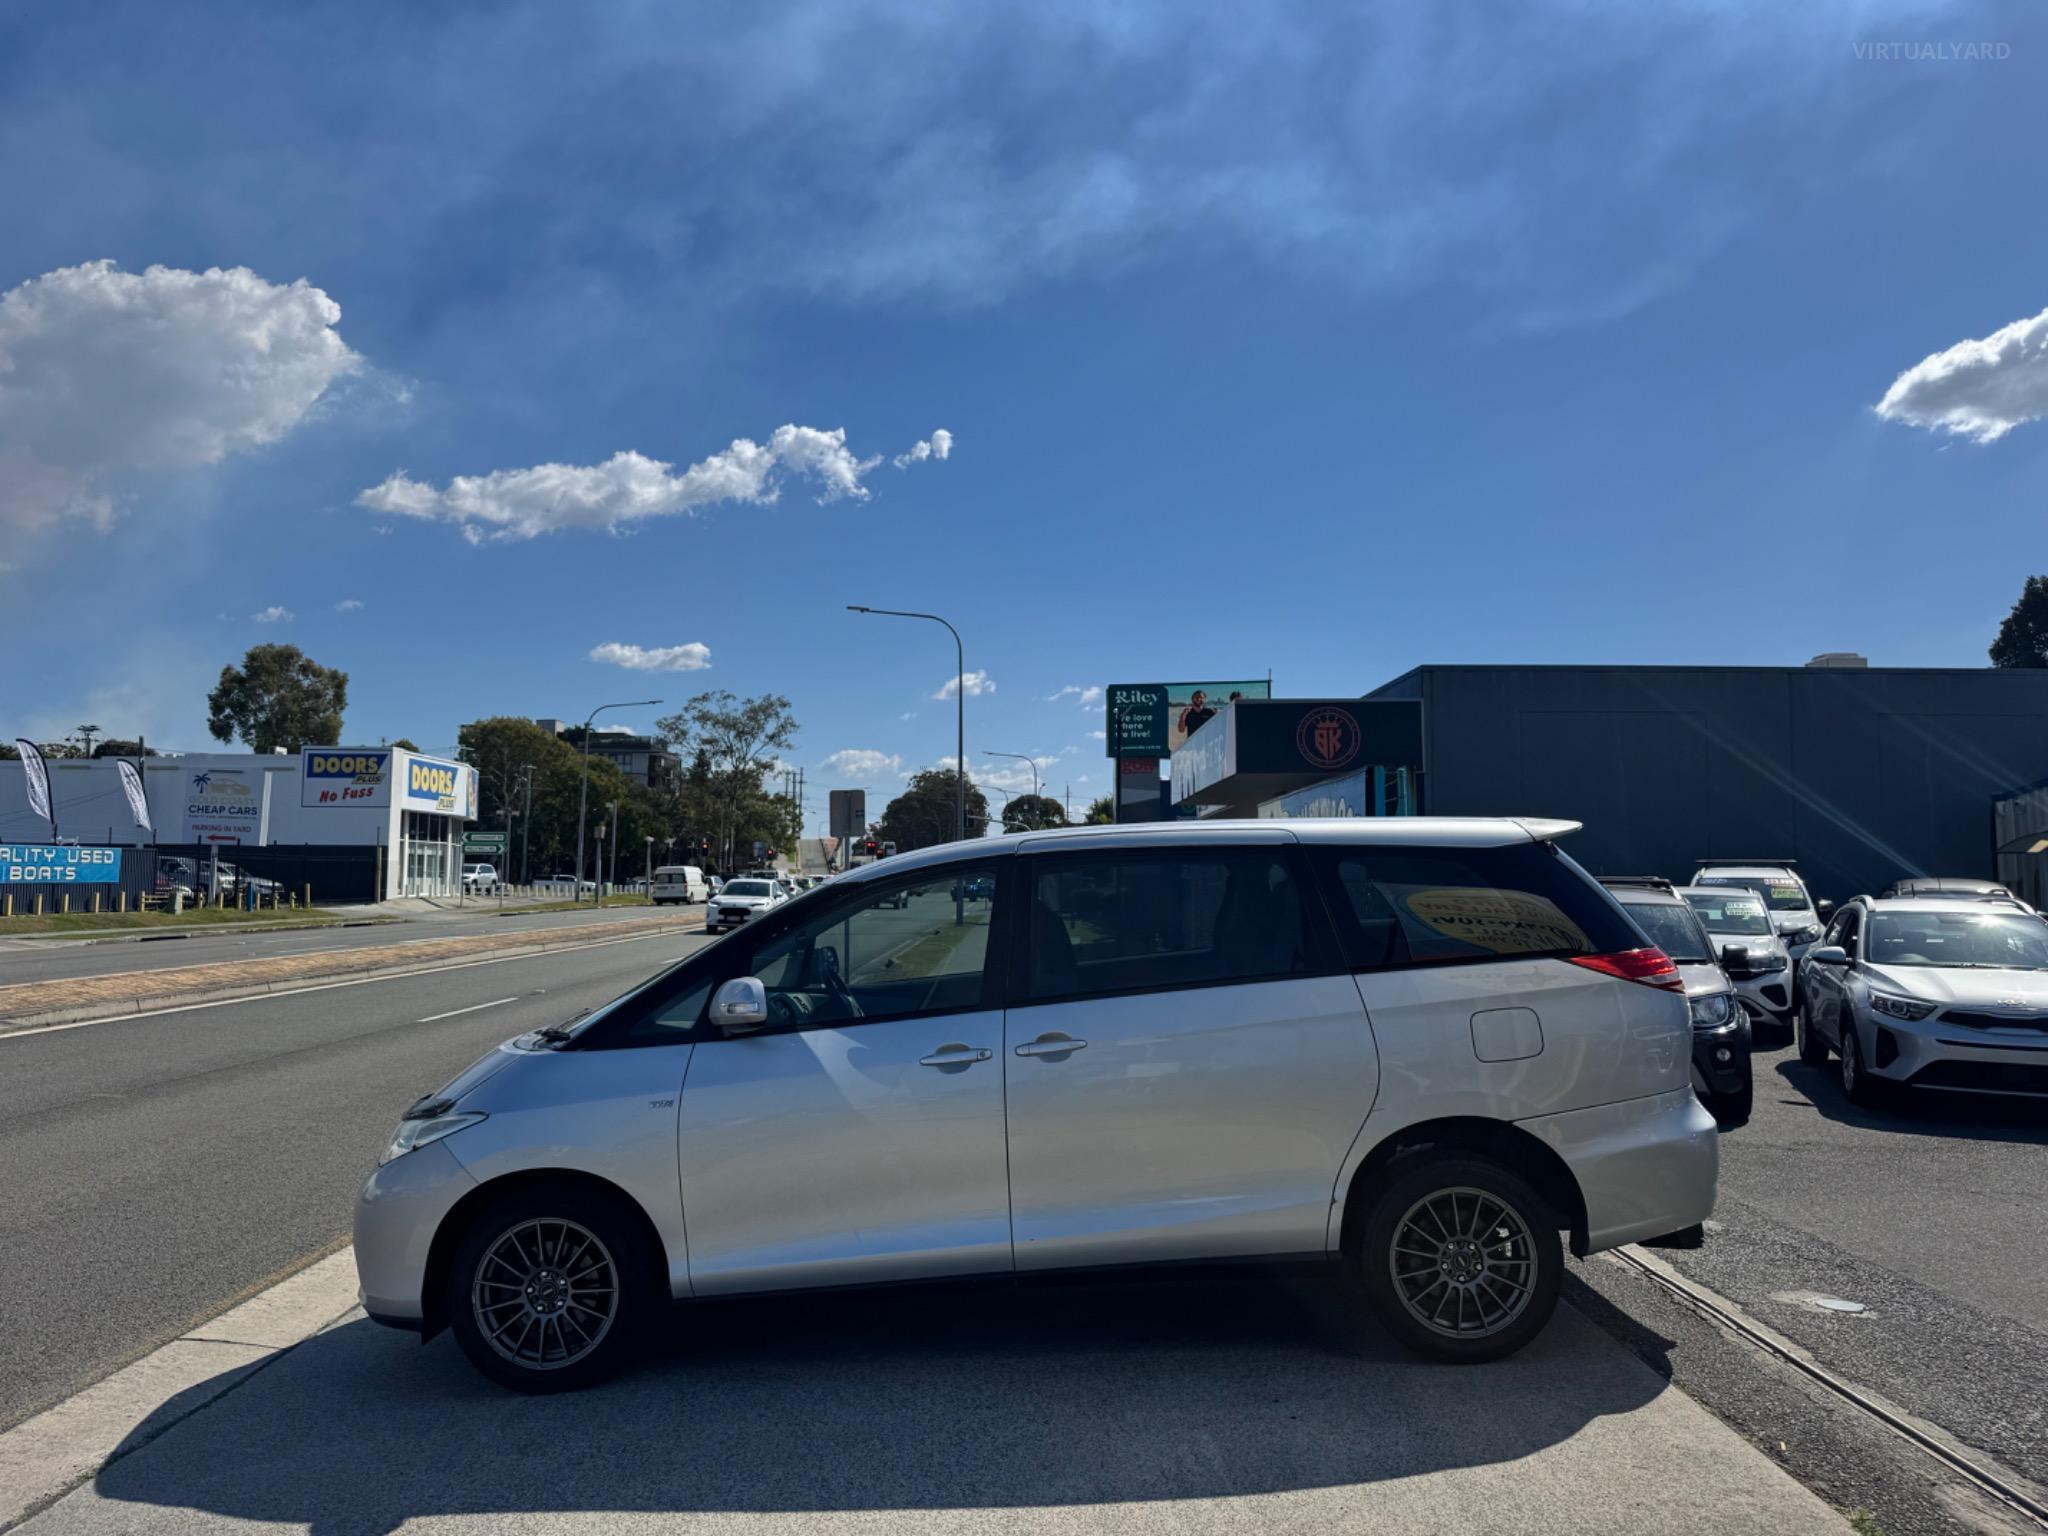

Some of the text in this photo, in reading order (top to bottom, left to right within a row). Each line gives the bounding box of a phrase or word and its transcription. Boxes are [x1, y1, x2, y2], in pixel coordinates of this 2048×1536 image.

[1115, 690, 1160, 706] Riley
[1132, 713, 1153, 722] love
[312, 756, 379, 774] DOORS
[355, 775, 382, 784] PLUS
[411, 764, 453, 794] DOORS
[319, 787, 375, 803] No Fuss
[188, 804, 258, 816] CHEAP CARS
[437, 798, 455, 809] PLUS
[0, 847, 114, 864] ALITY USED
[9, 865, 77, 881] BOATS
